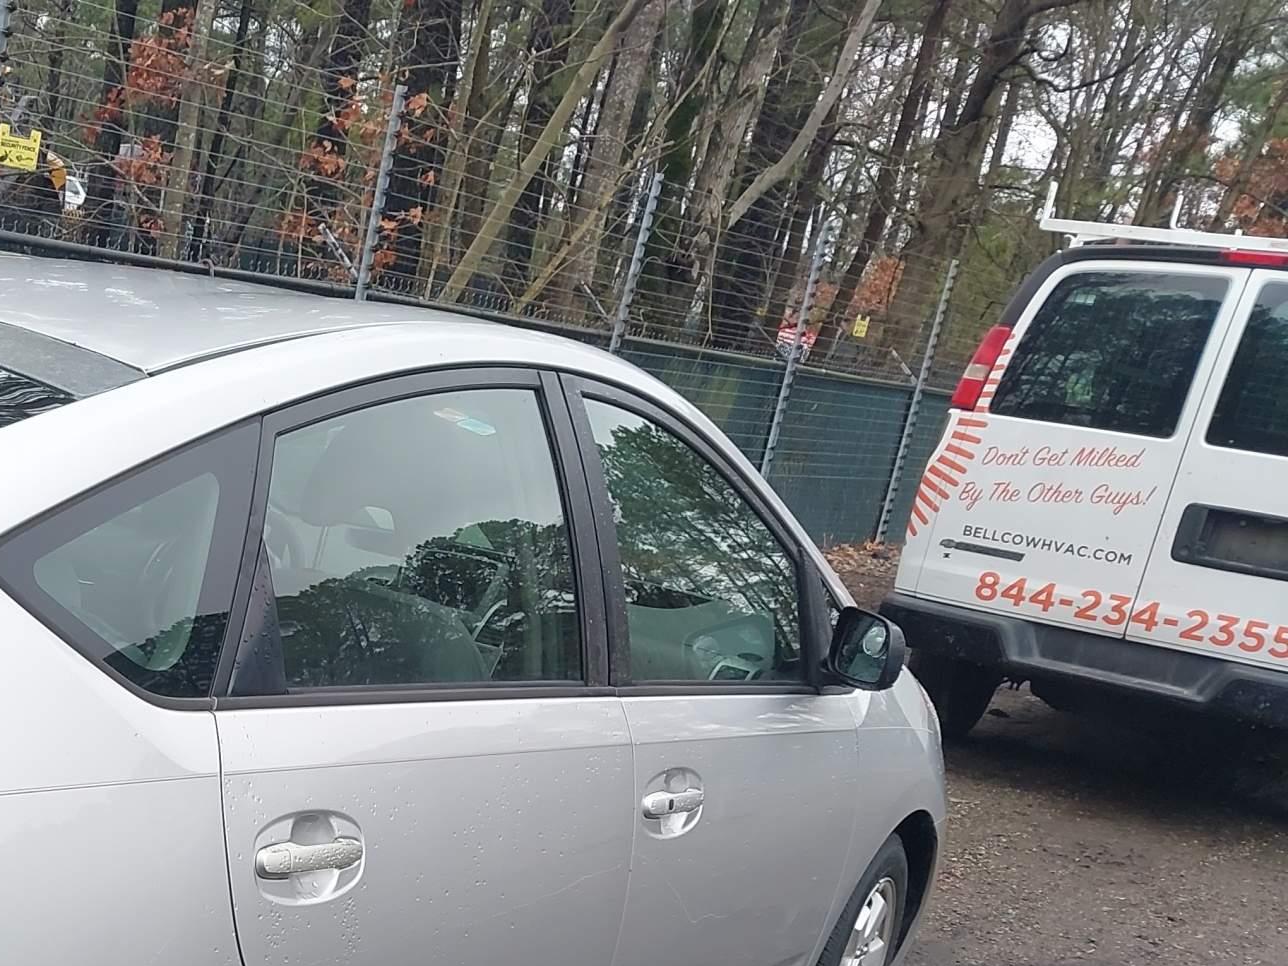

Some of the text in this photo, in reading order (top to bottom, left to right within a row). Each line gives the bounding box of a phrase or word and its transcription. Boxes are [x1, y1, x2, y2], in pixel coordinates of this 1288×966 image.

[981, 446, 1146, 468] Don't Get Milked
[958, 481, 1157, 516] By The Other Guys!
[962, 525, 1133, 565] BELLCOWHVAC.COM
[975, 571, 1288, 659] 844-234-2355
